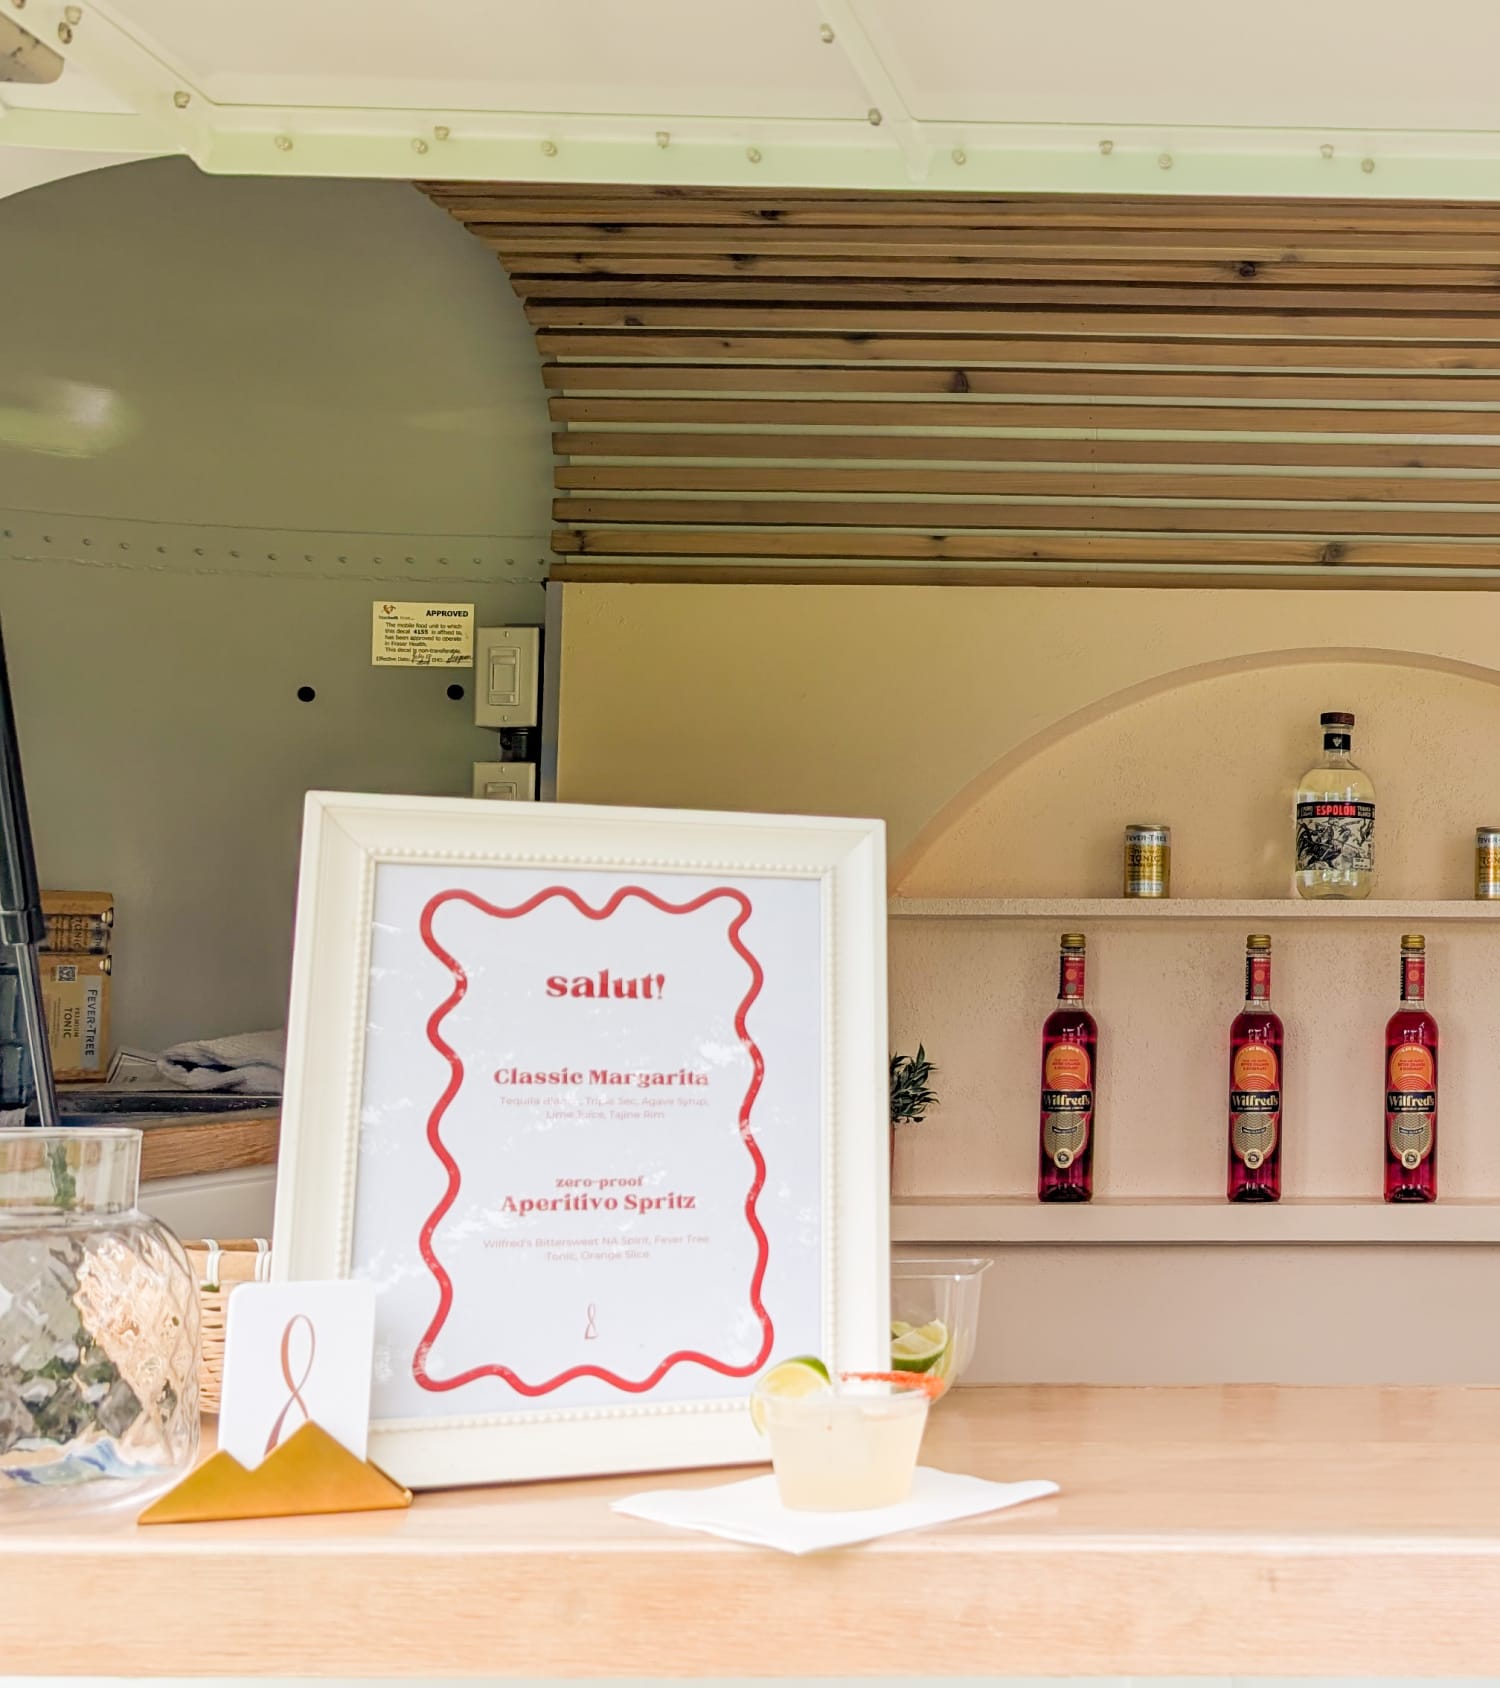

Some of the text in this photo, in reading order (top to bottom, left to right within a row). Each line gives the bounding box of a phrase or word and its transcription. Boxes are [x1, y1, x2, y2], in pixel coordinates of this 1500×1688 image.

[426, 610, 469, 618] APPROVED
[545, 969, 665, 1000] salut!
[63, 1007, 73, 1039] TONIC
[85, 989, 98, 1056] FEVER-TREE
[494, 1068, 709, 1089] Classic Margarita
[500, 1096, 540, 1106] Tequila
[642, 1096, 674, 1107] Agave
[1232, 1095, 1278, 1107] Wilfred's
[1389, 1095, 1434, 1107] Wilfred's
[610, 1110, 640, 1120] Tajine
[643, 1110, 665, 1119] Rim
[556, 1176, 645, 1190] zero-proof
[501, 1192, 696, 1216] Aperitivo Spritz
[483, 1239, 532, 1249] Wilfred's
[535, 1237, 599, 1248] Bittersweet
[601, 1237, 618, 1245] NA
[654, 1235, 683, 1244] Fever
[687, 1234, 710, 1243] Tree
[581, 1250, 621, 1261] Orange
[624, 1249, 649, 1259] Slice
